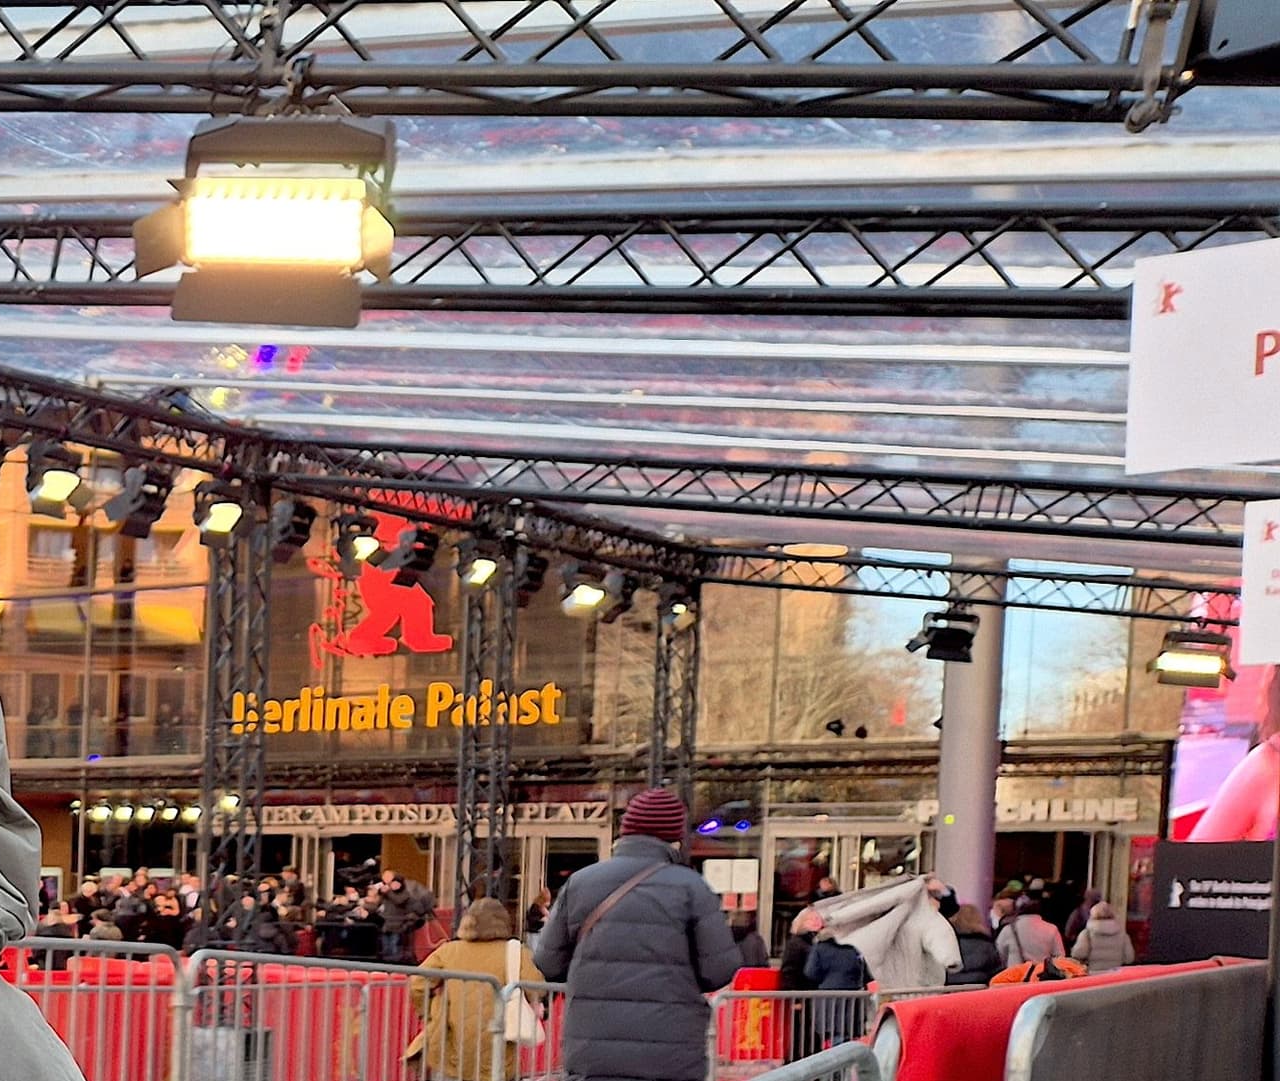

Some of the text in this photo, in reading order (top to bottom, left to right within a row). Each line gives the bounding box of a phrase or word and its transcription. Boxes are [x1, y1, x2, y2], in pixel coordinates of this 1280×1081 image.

[231, 678, 563, 735] Berlinale Palast
[521, 802, 608, 823] PLATZ
